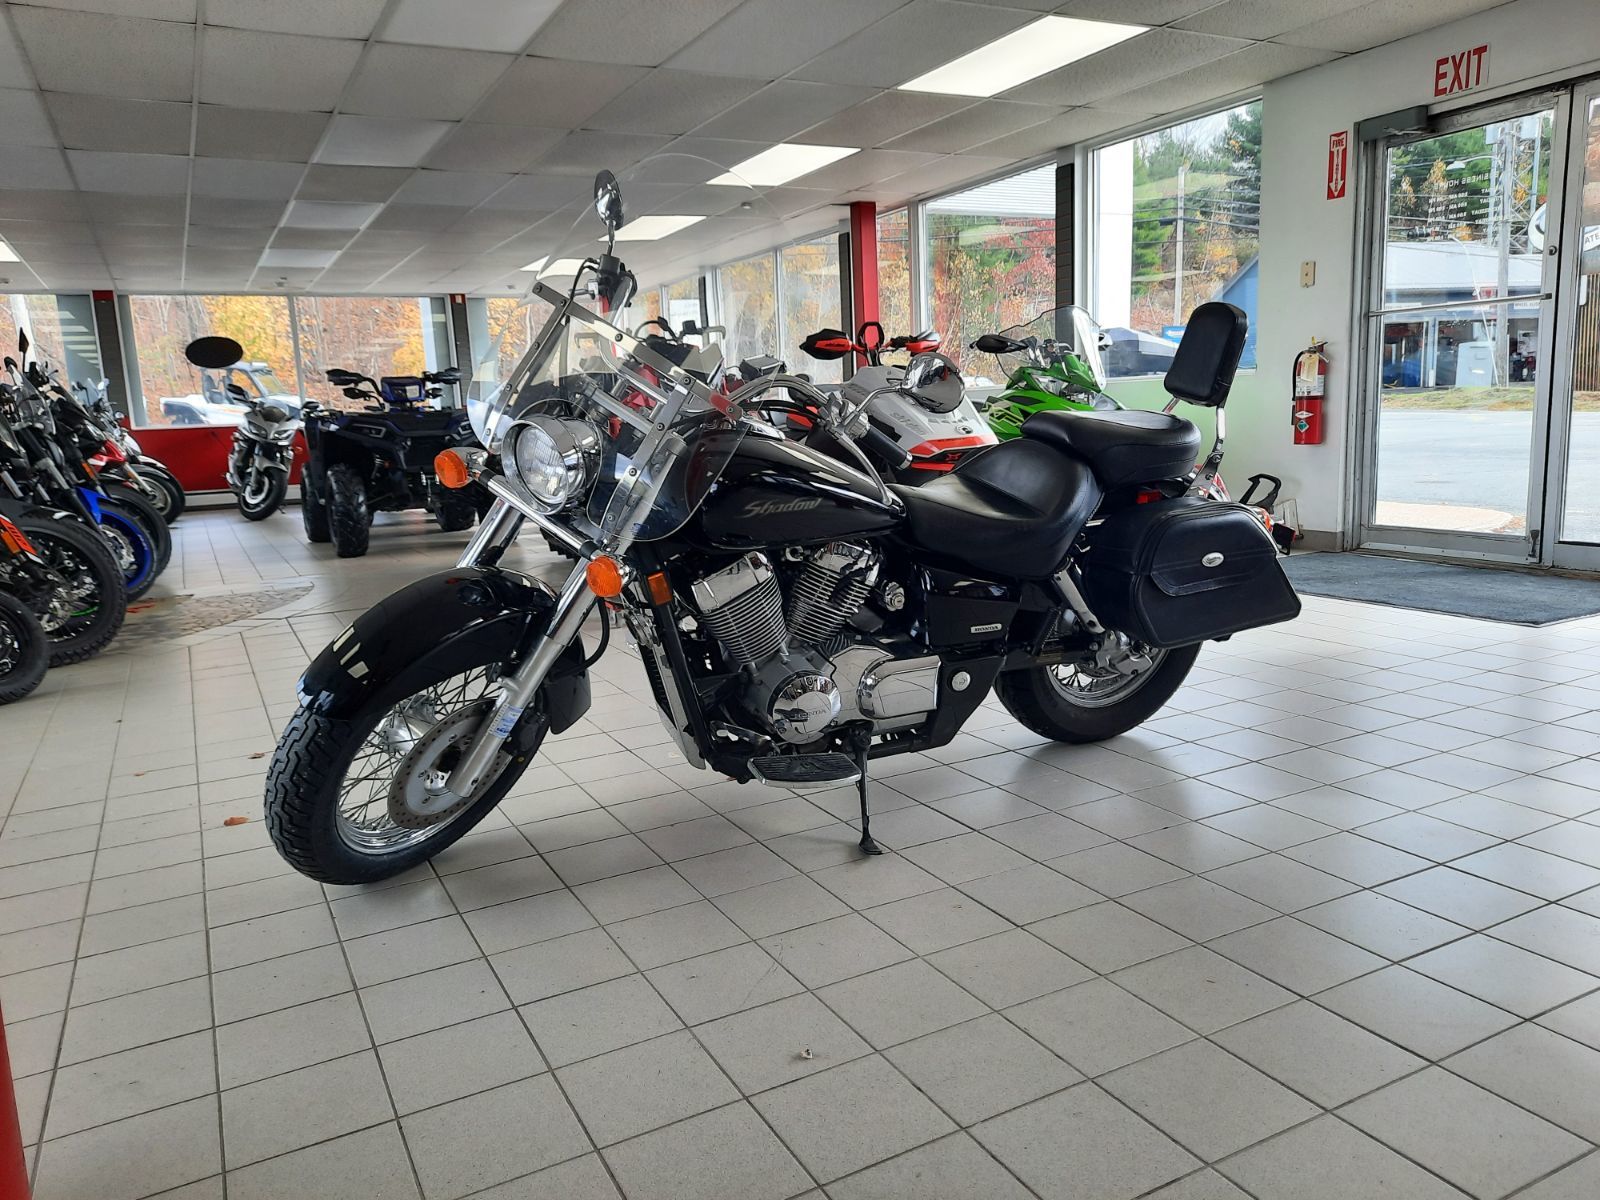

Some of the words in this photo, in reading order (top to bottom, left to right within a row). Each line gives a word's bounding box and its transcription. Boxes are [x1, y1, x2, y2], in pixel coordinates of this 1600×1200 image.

[1434, 45, 1488, 97] EXIT
[1332, 137, 1345, 149] FIRE
[739, 497, 823, 518] Shadow
